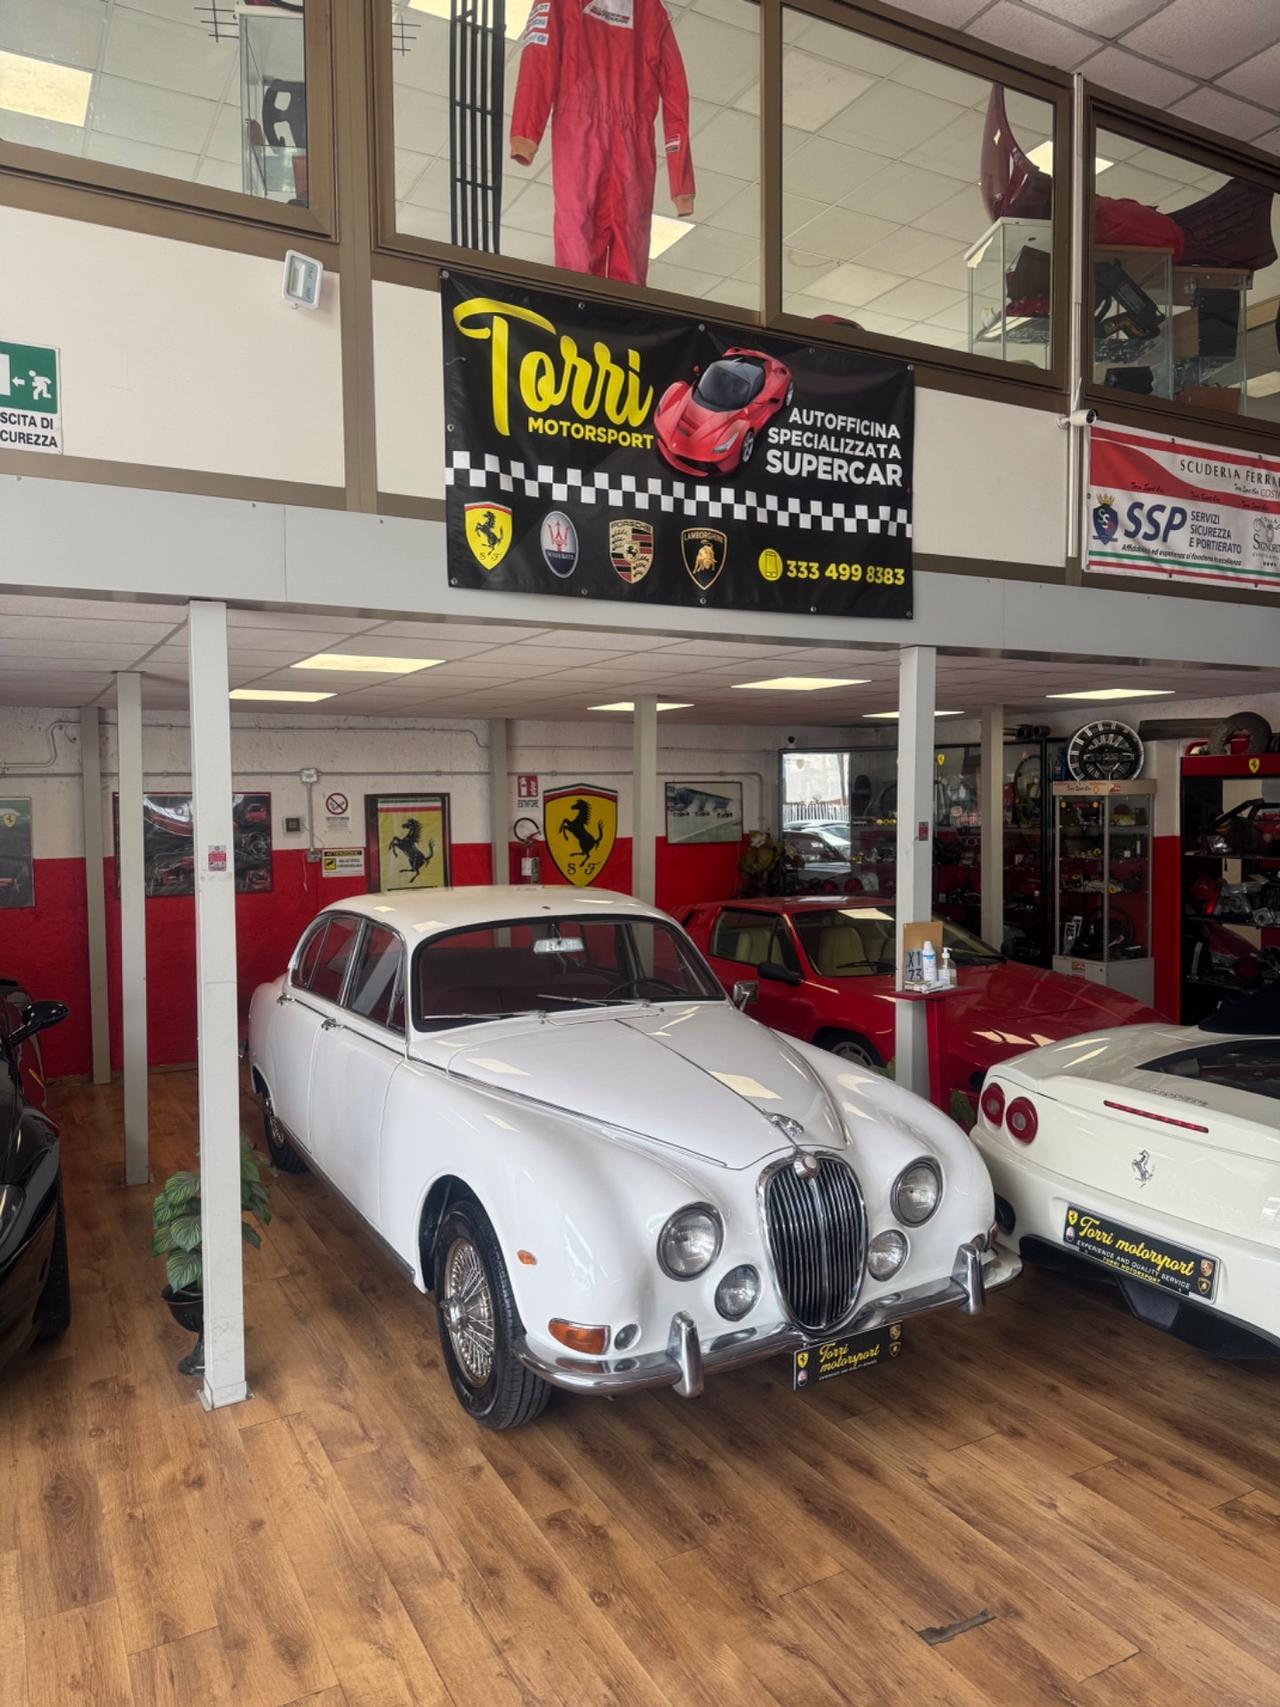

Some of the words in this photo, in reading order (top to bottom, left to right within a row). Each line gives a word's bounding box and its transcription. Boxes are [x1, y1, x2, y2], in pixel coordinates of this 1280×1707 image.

[453, 298, 654, 436] Torri
[0, 411, 37, 428] SCITA
[41, 417, 53, 430] DI
[528, 416, 654, 449] MOTORSPORT
[789, 407, 901, 439] AUTOFFICINA
[0, 429, 58, 448] CUREZZA
[768, 427, 901, 459] SPECIALIZZATA
[765, 449, 903, 487] SUPERCAR
[1180, 459, 1241, 480] SCUDERIA
[1246, 470, 1280, 488] FERRA
[1124, 501, 1188, 543] SSP
[1190, 524, 1231, 540] SICUREZZA
[1191, 510, 1220, 525] SERVIZI
[1189, 537, 1194, 547] E
[1196, 538, 1242, 554] PORTIERATO
[786, 560, 820, 580] 333
[825, 563, 862, 581] 499
[866, 565, 905, 586] 8383
[567, 863, 576, 875] S
[1079, 1216, 1114, 1245] Torri
[1115, 1239, 1194, 1276] motorsport
[1076, 1240, 1115, 1259] EXPERIENCE
[1117, 1255, 1130, 1265] AND
[1131, 1261, 1160, 1277] QUALITY
[1161, 1273, 1190, 1289] SERVICE
[820, 1342, 849, 1363] Torri
[820, 1343, 880, 1373] motorsport
